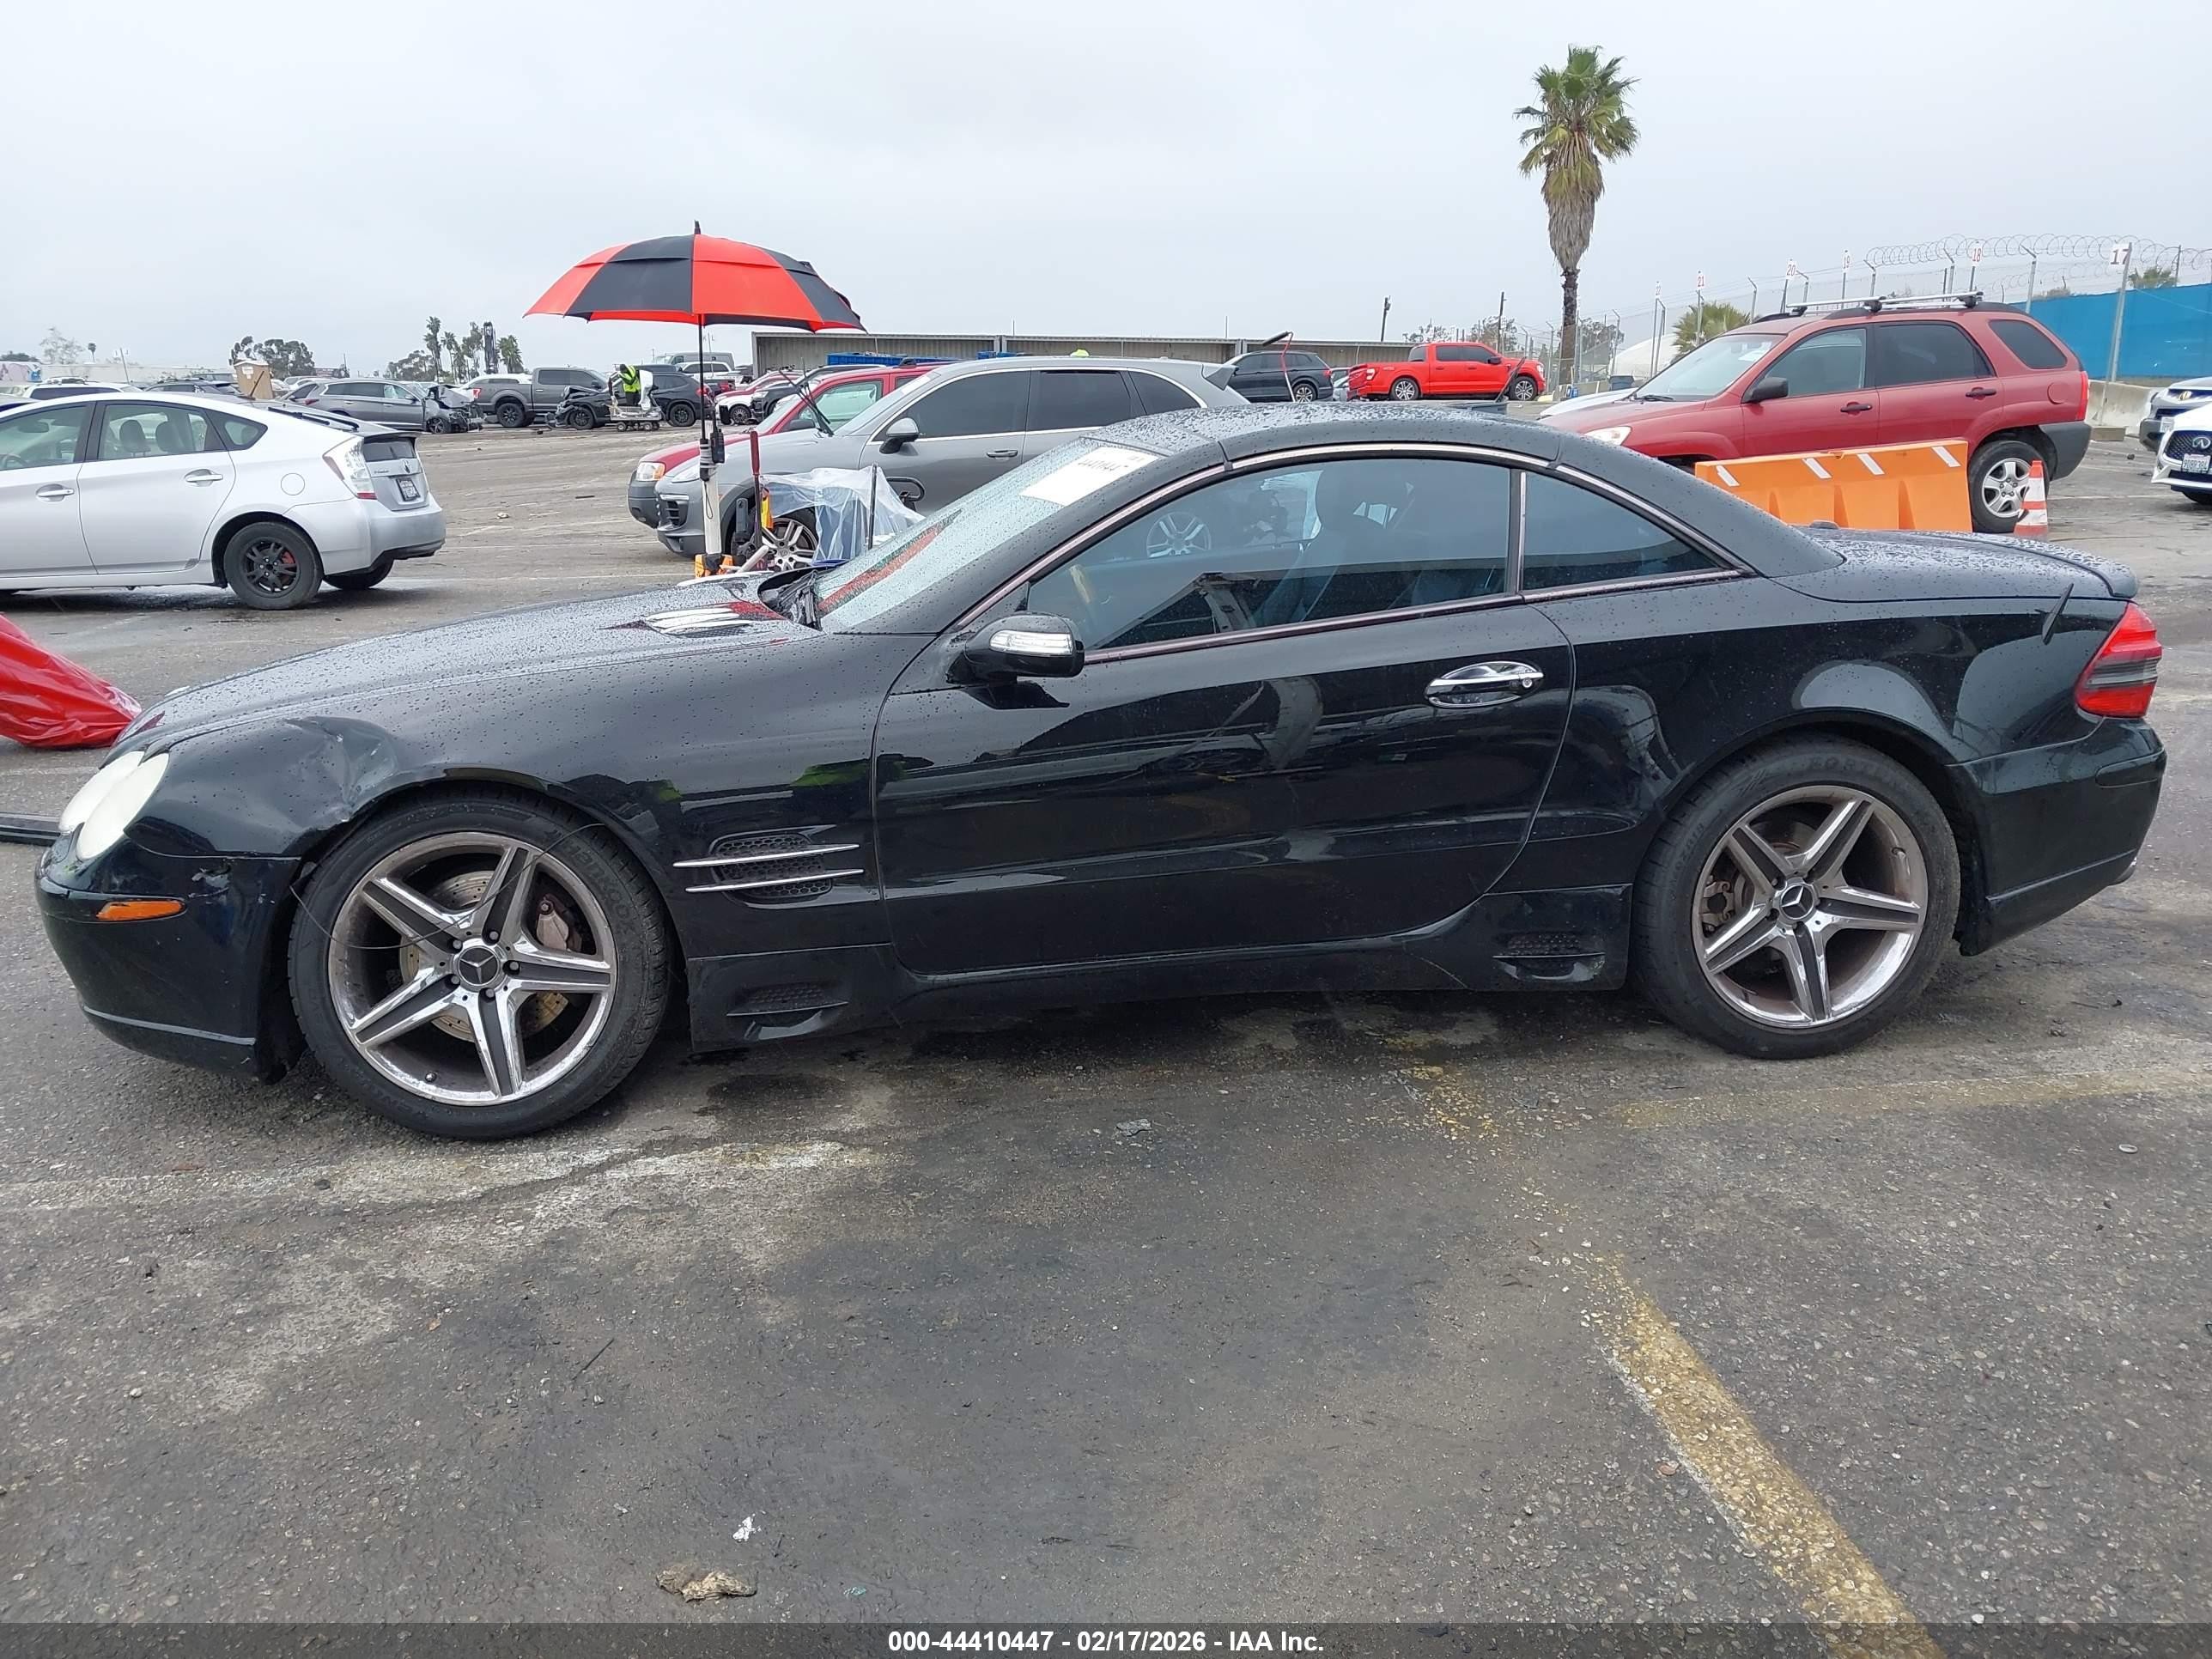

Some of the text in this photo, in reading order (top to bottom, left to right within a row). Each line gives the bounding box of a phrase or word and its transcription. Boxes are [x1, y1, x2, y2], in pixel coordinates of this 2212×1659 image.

[1972, 248, 1981, 262] 18
[2110, 248, 2130, 264] 17
[1787, 264, 1796, 276] 20
